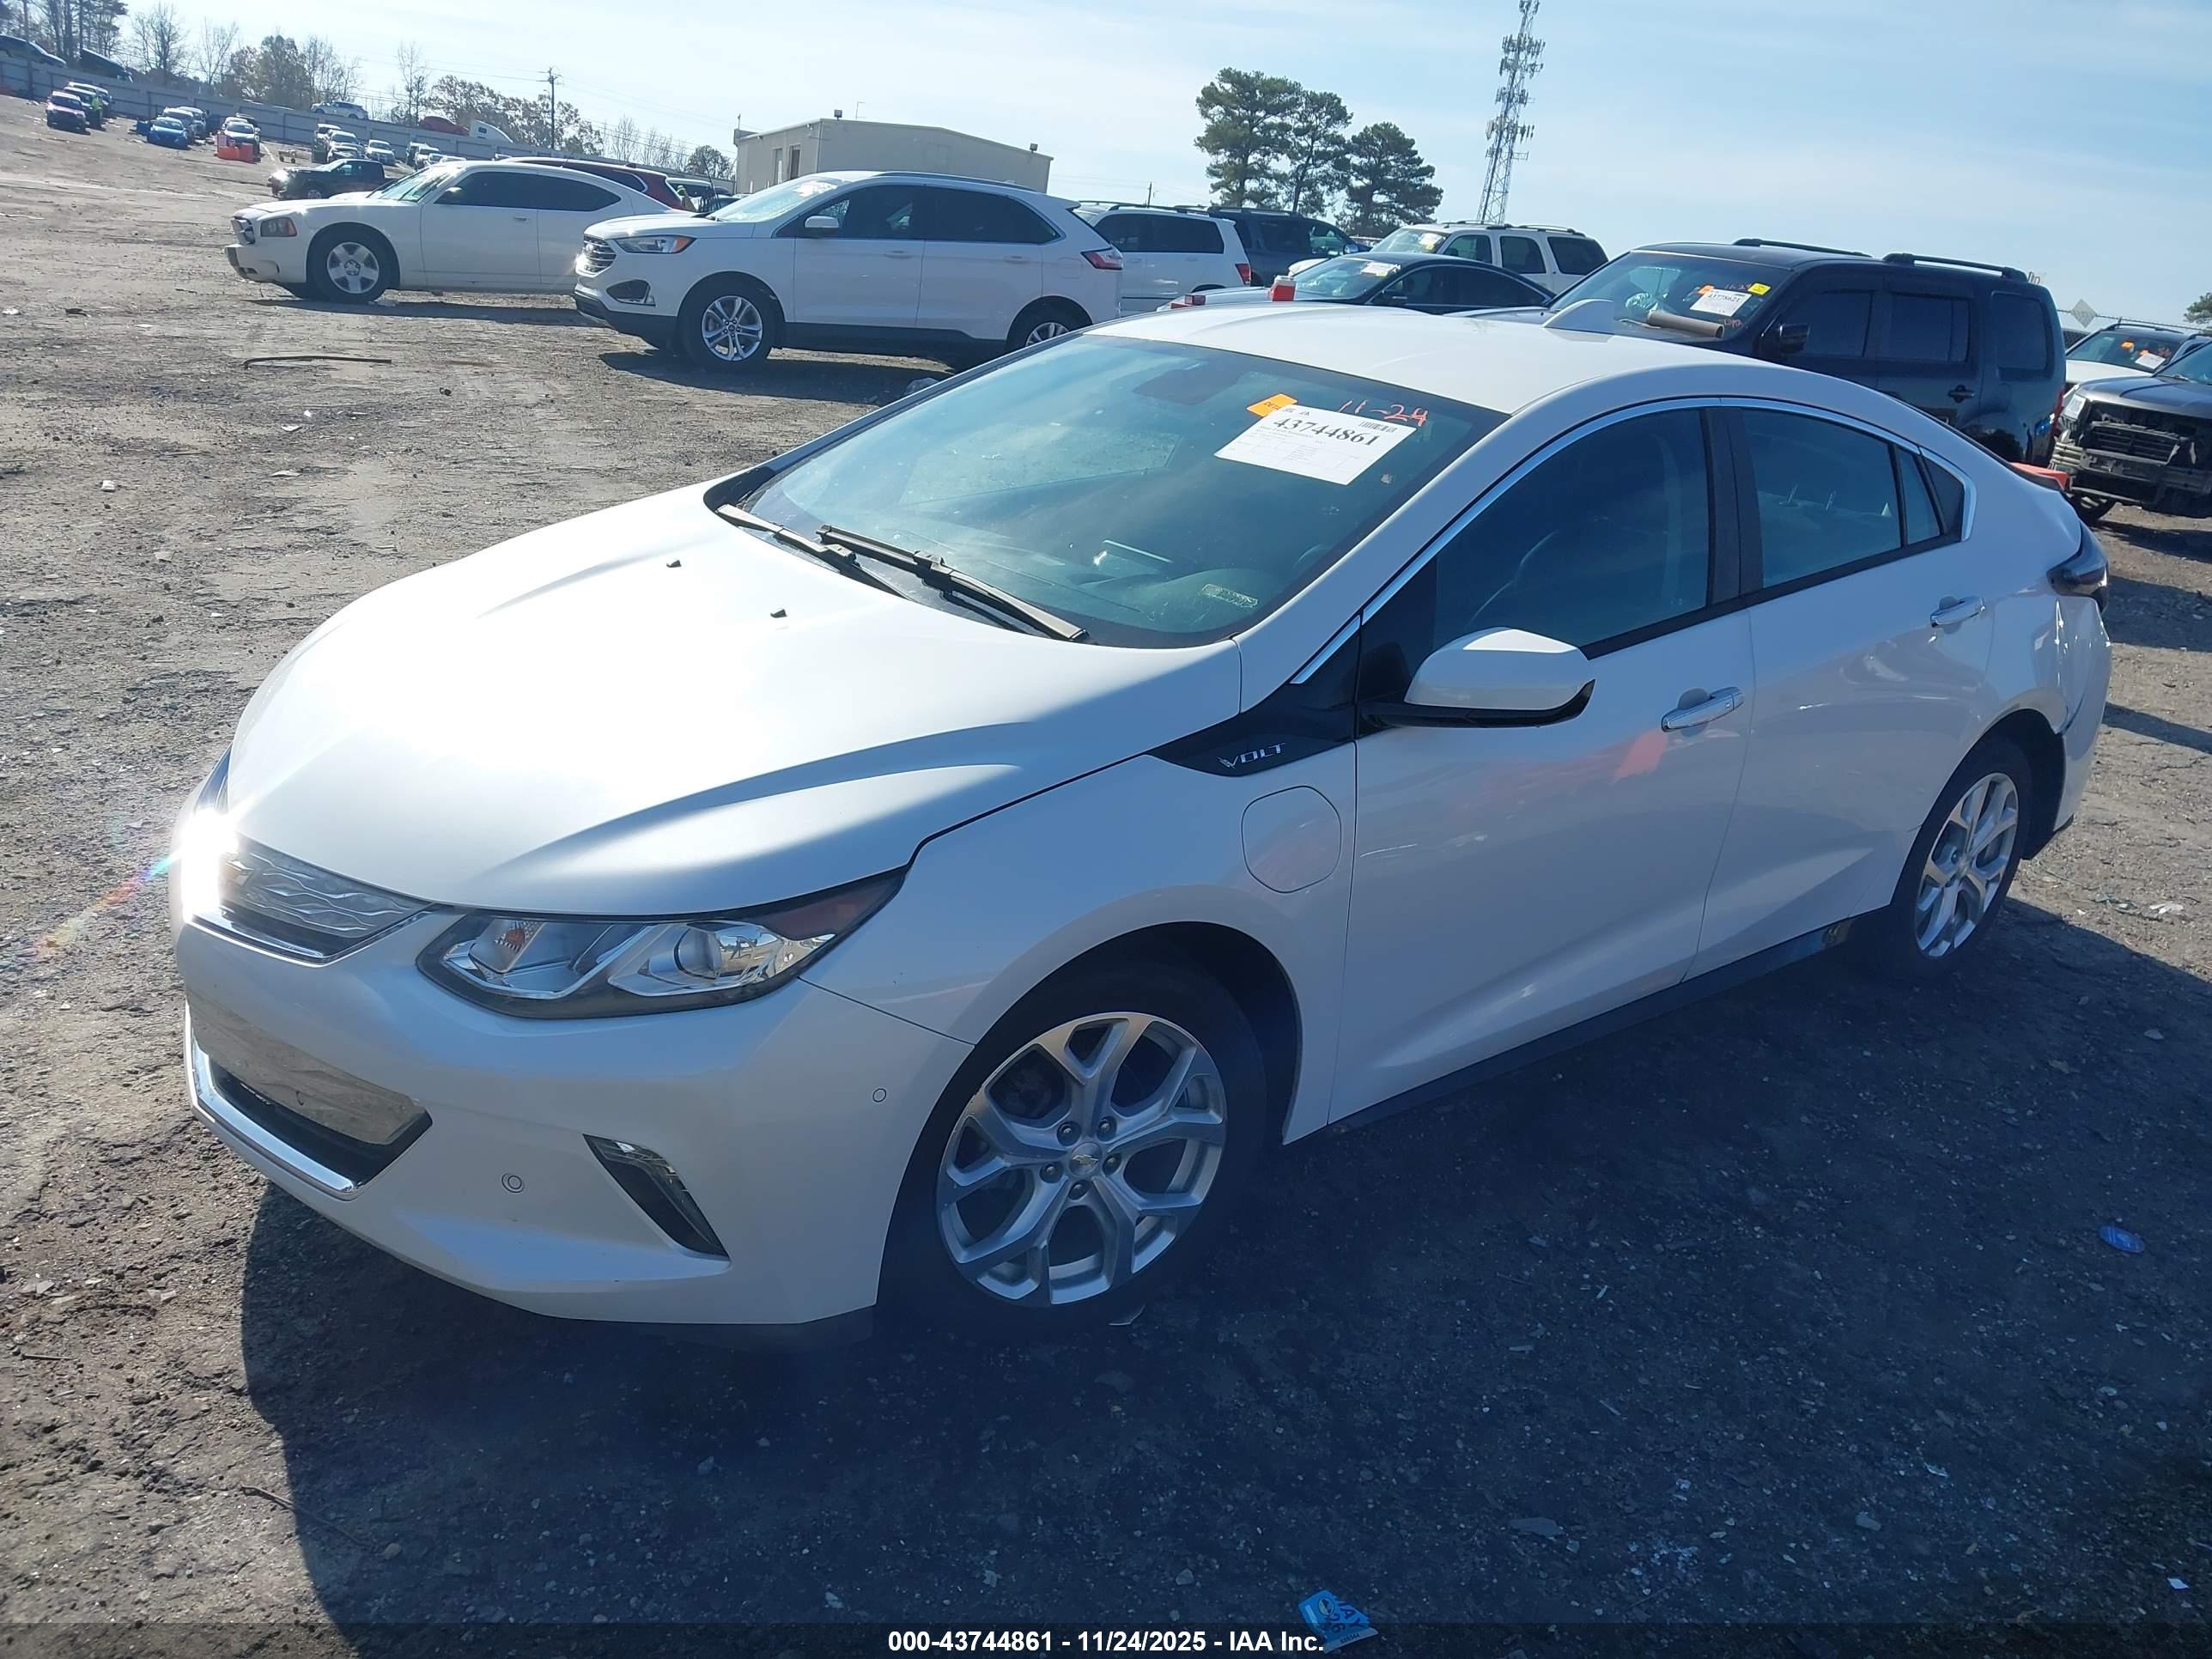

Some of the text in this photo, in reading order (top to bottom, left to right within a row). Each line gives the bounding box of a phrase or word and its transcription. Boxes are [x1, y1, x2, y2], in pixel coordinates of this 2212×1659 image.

[1337, 398, 1430, 427] 11-24
[1273, 416, 1382, 447] 43744861
[1216, 742, 1285, 769] VOLT
